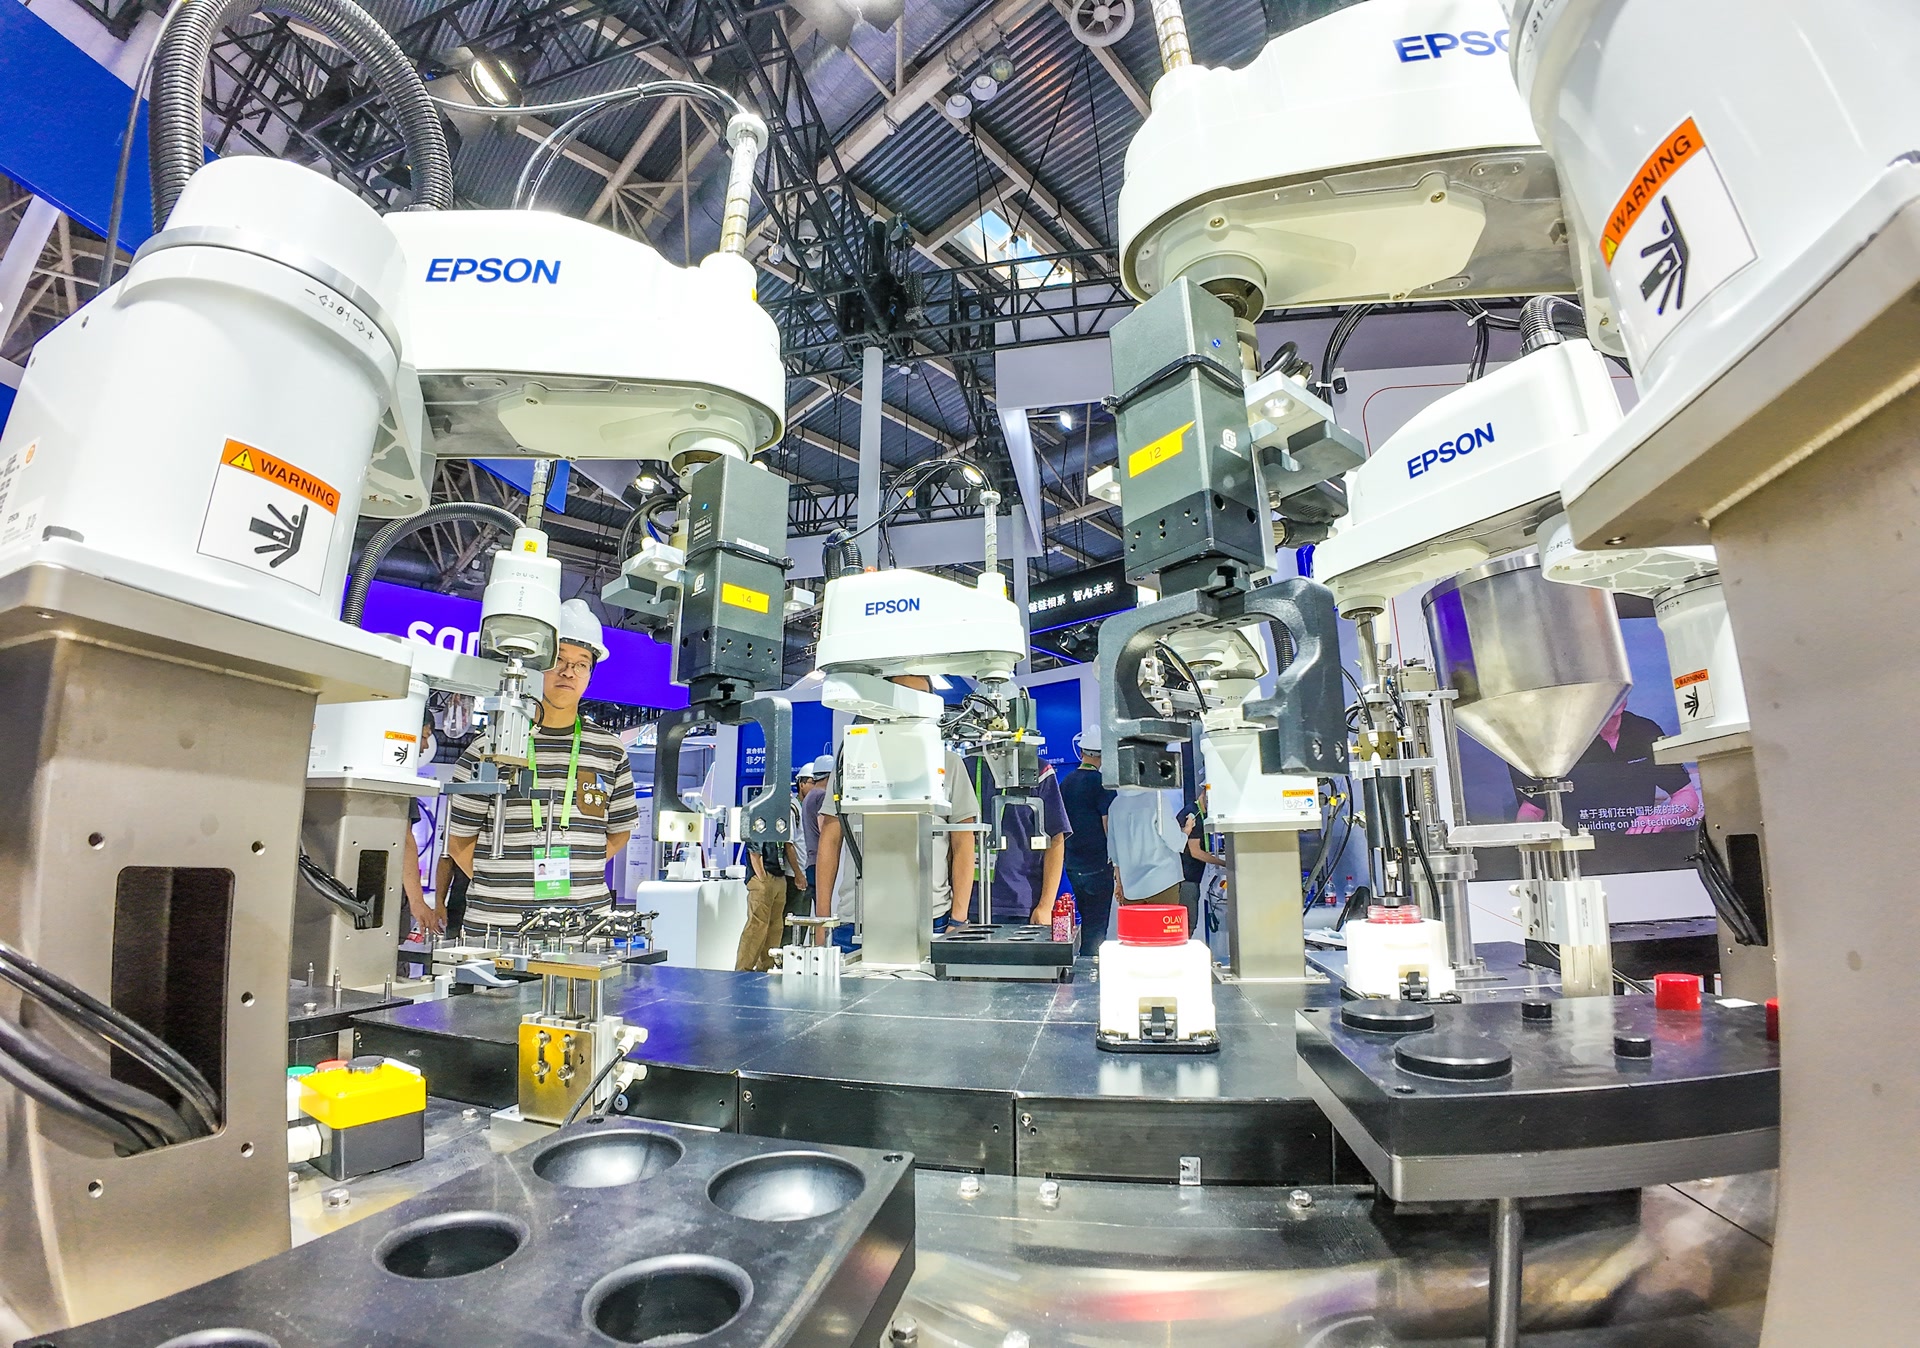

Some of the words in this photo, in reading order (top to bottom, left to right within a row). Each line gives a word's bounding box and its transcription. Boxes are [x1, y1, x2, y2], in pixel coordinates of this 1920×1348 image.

[1612, 134, 1692, 234] WARNING
[425, 257, 562, 284] EPSON
[1149, 446, 1162, 462] 12
[1407, 422, 1495, 479] EPSON
[261, 458, 335, 507] WARNING
[741, 593, 752, 604] 14
[865, 597, 920, 616] EPSON
[1680, 672, 1706, 685] WARNING
[1618, 821, 1629, 829] on
[1631, 818, 1646, 828] the
[1162, 915, 1183, 925] OLAY
[617, 1097, 623, 1106] 5
